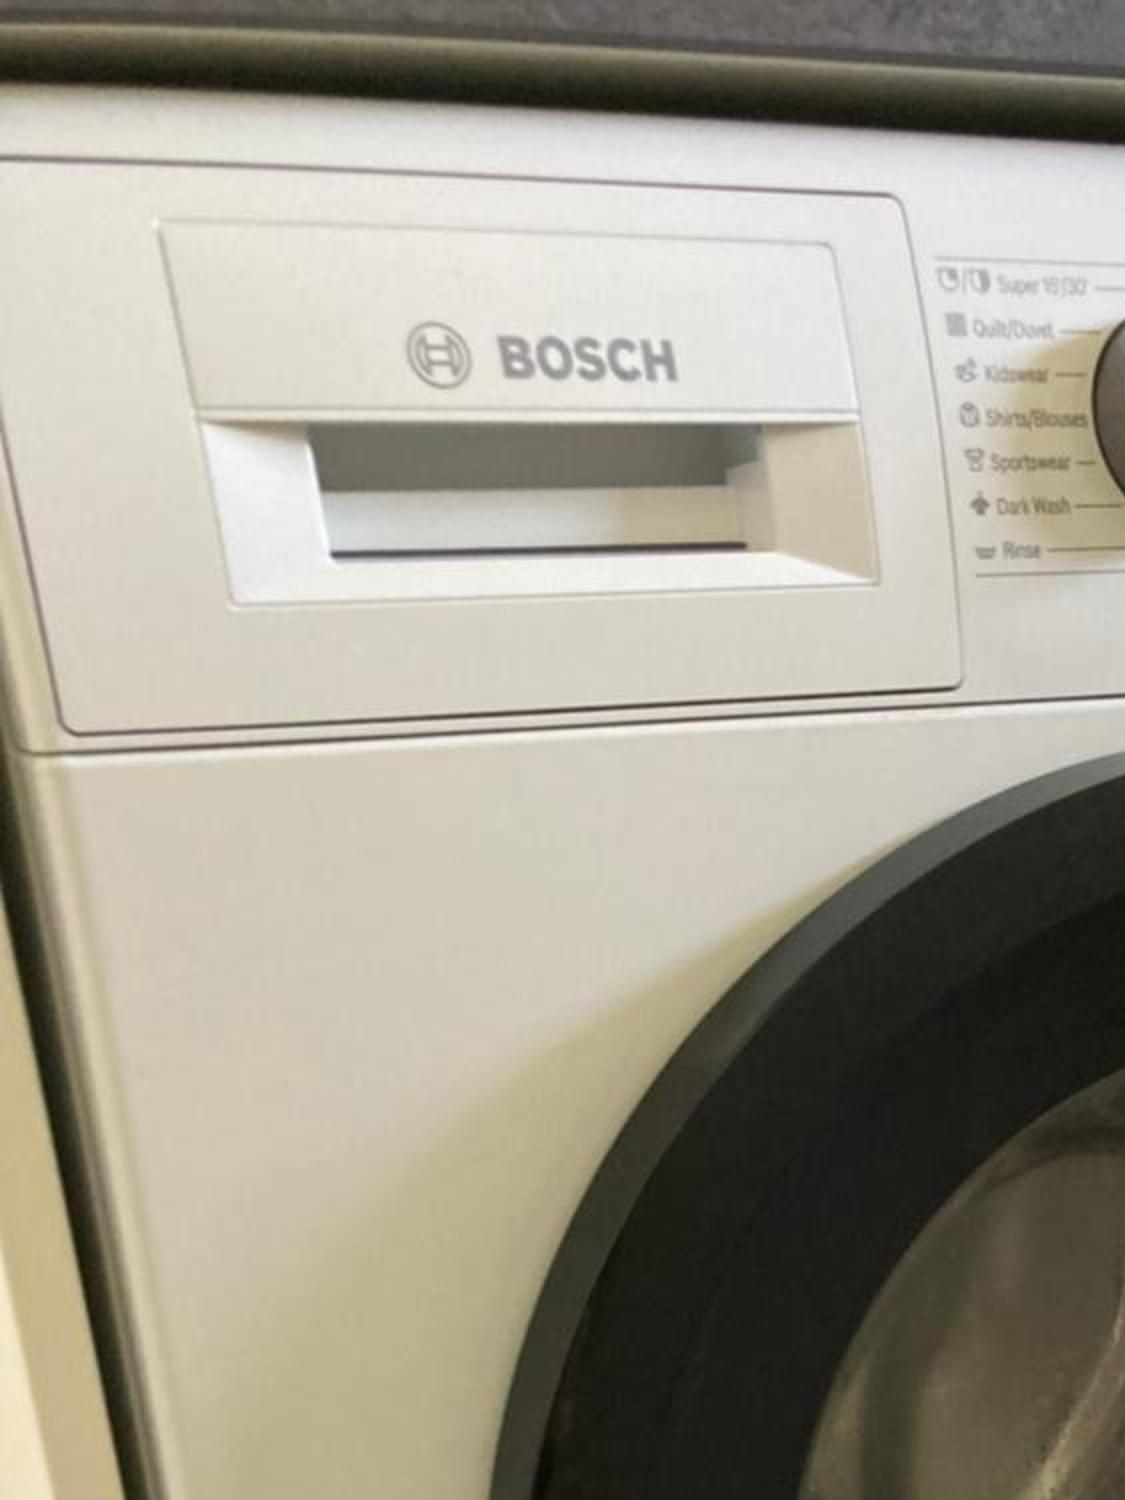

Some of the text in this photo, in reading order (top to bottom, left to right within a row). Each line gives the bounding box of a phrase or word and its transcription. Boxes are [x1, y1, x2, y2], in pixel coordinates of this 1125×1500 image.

[996, 275, 1039, 297] Super
[496, 335, 679, 382] BOSCH
[983, 365, 1050, 384] Kidswear
[984, 409, 1089, 430] Shirts/Blouses
[990, 454, 1071, 474] Sportswear
[995, 498, 1071, 515] Dark Wash
[1002, 541, 1042, 559] Rinse
